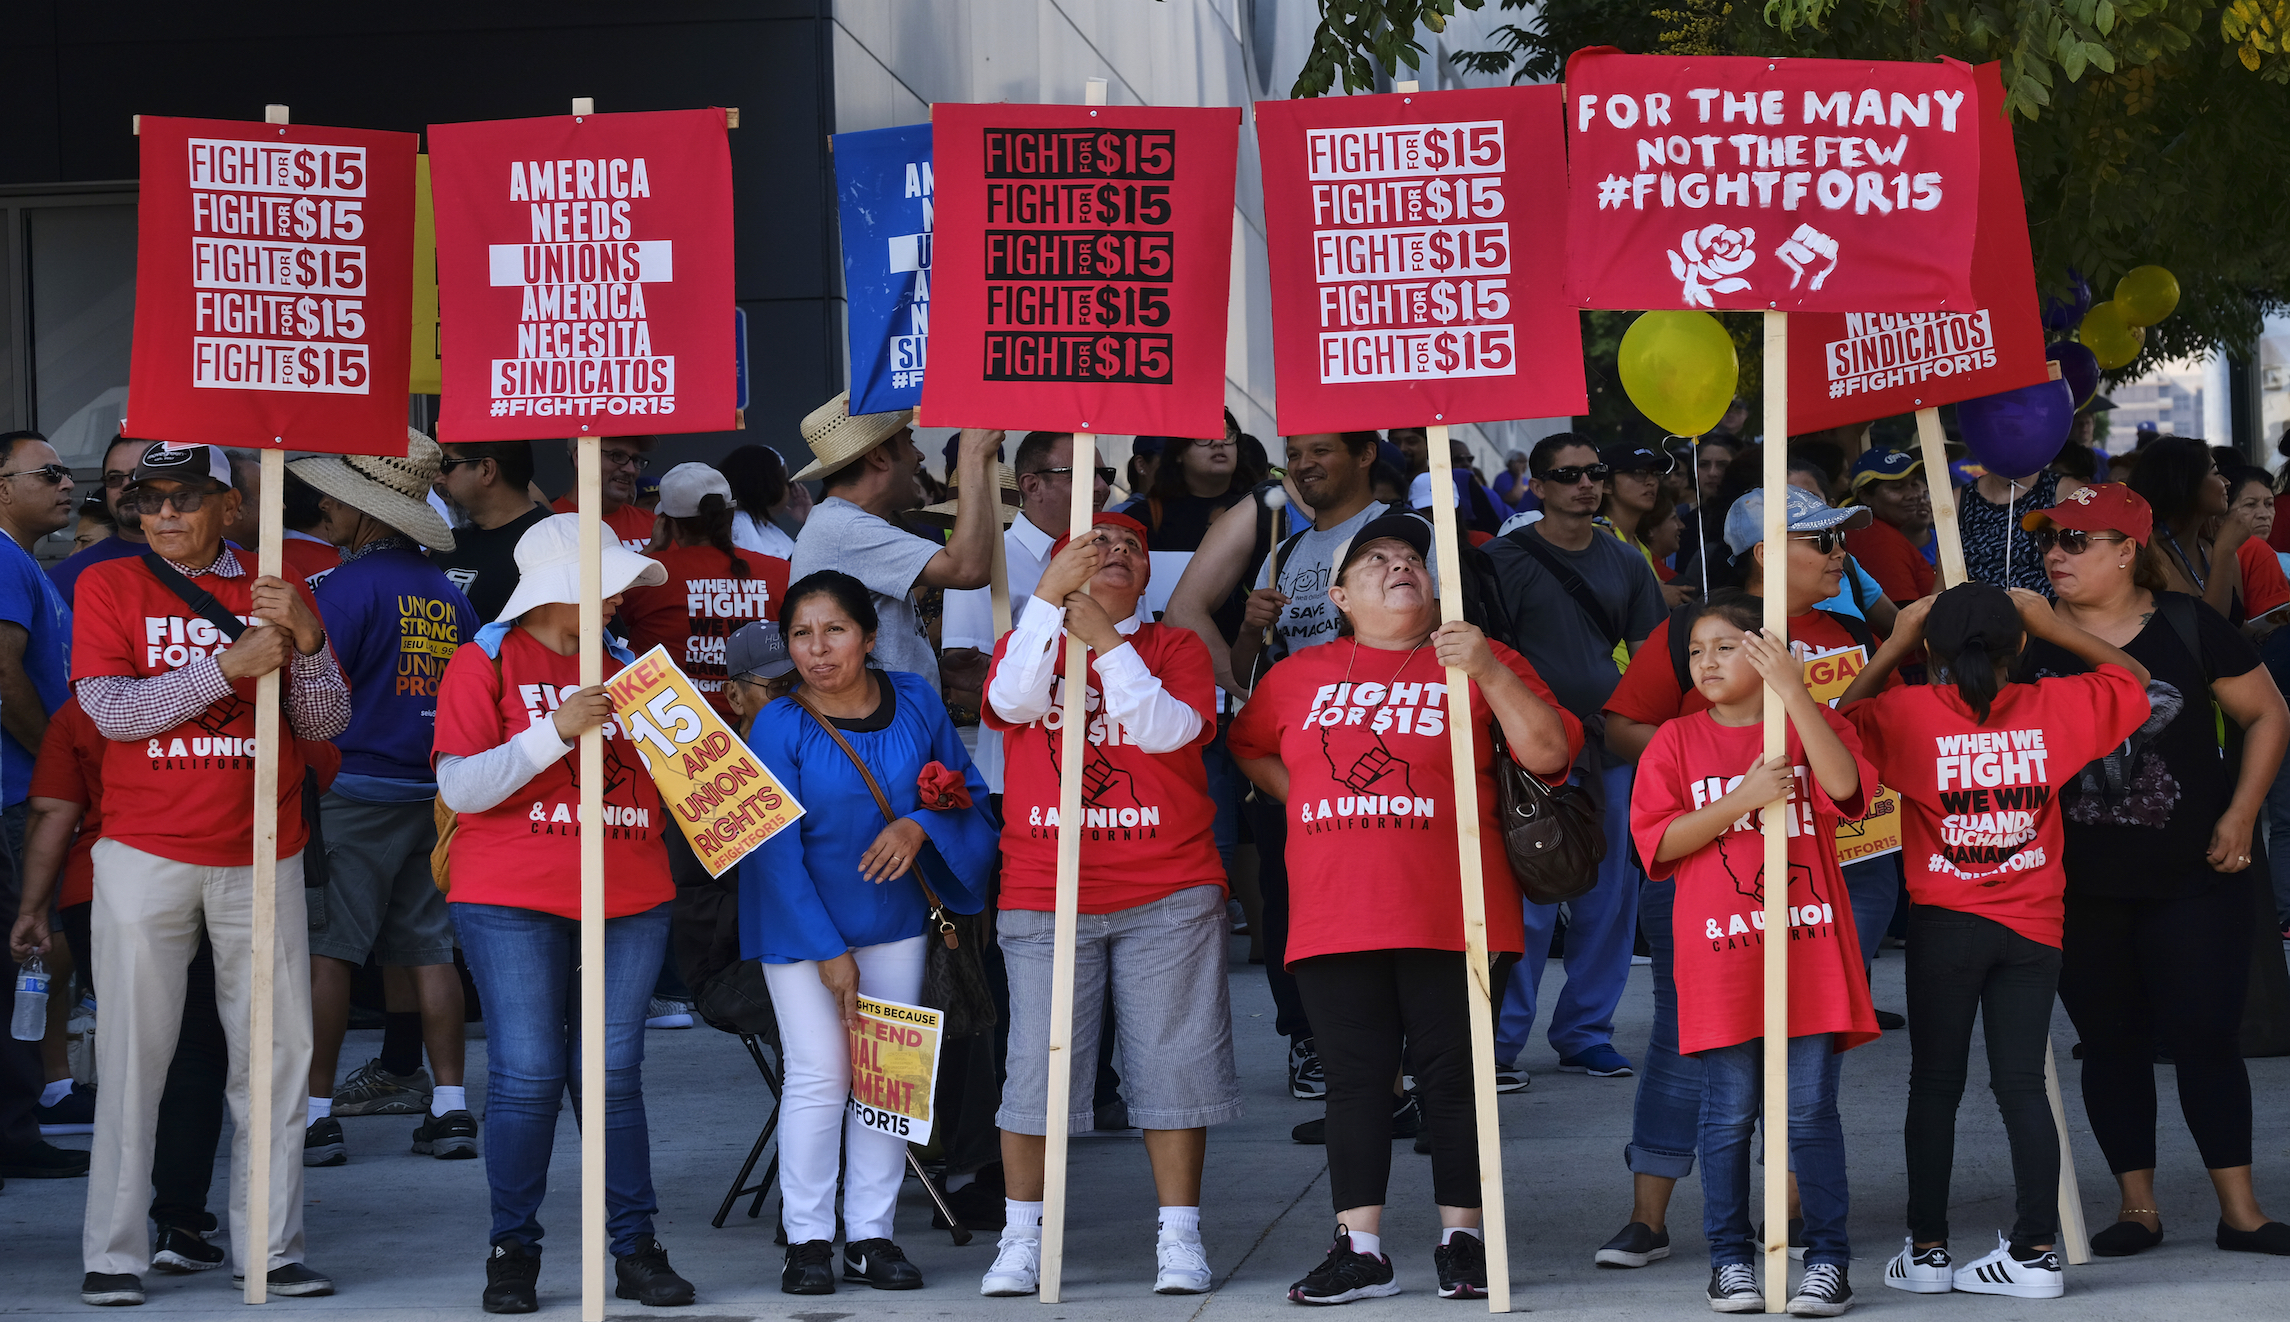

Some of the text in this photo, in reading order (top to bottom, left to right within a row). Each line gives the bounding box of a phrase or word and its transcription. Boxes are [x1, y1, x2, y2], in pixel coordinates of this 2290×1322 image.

[1578, 88, 1964, 133] FOR THE MANY
[192, 144, 363, 190] FIGHT FOR $15
[986, 132, 1172, 176] FIGHT FOR $15
[1310, 127, 1501, 173] FIGHT FOR $15
[1637, 133, 1909, 171] NOT THE FEW
[510, 158, 650, 201] AMERICA
[1312, 177, 1505, 225] FIGHT FOR $15
[1598, 168, 1943, 216] #FIGHTFOR15
[193, 193, 364, 240] FIGHT FOR $15
[531, 200, 631, 243] NEEDS
[987, 182, 1171, 226] FIGHT FOR $15
[196, 243, 363, 289] FIGHT FOR $15
[523, 243, 640, 283] UNIONS
[987, 233, 1171, 278] FIGHT FOR $15
[1317, 229, 1506, 275] FIGHT FOR $15
[196, 292, 366, 339] FIGHT FOR $15
[521, 283, 646, 321] AMERICA
[988, 284, 1170, 328] FIGHT FOR $15
[1319, 279, 1510, 327] FIGHT FOR $15
[518, 321, 652, 358] NECESITA
[986, 335, 1170, 379] FIGHT FOR $15
[1323, 331, 1512, 377] FIGHT FOR $15
[1835, 313, 1986, 376] SINDICATOS
[197, 343, 367, 388] FIGHT FOR $15
[501, 359, 667, 395] SINDICATOS
[1829, 349, 1997, 399] #FIGHTFOR15
[490, 397, 675, 417] #FIGHTFOR15
[2067, 486, 2097, 505] SC
[686, 579, 768, 593] WHEN WE
[687, 593, 769, 618] FIGHT
[689, 618, 724, 635] WE
[1290, 603, 1325, 619] SAVE
[403, 640, 424, 649] SEIU
[1311, 682, 1448, 711] FIGHT
[1302, 706, 1444, 737] FOR $15
[1936, 729, 2045, 757] WHEN WE
[147, 737, 256, 758] & A UNIO
[682, 731, 731, 780] AND
[676, 756, 760, 823] UNION
[1936, 749, 2048, 792] FIGHT
[529, 801, 547, 822] &
[550, 803, 572, 824] A
[1029, 806, 1041, 826] &
[1044, 807, 1061, 827] A
[1301, 795, 1435, 823] & A UNION
[1939, 785, 2050, 814] WE WIN
[693, 786, 783, 858] RIGHTS
[713, 813, 787, 871] #FIGHTFOR15
[1306, 817, 1430, 835] CALIFORNIA
[1706, 918, 1725, 940] &
[1728, 914, 1750, 936] A
[856, 1000, 936, 1025] GHTS BECAUSE
[876, 1022, 923, 1048] END
